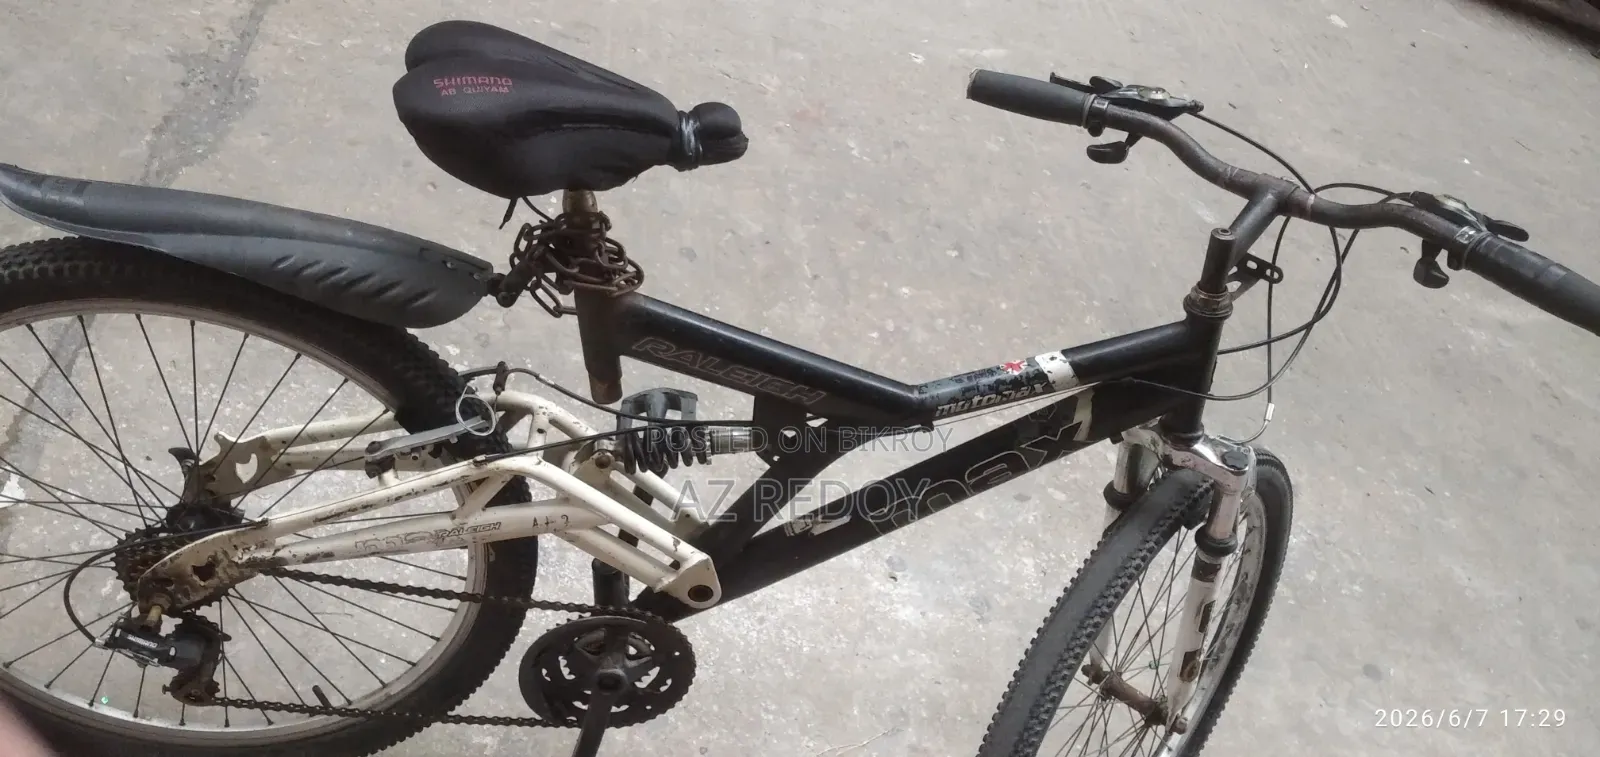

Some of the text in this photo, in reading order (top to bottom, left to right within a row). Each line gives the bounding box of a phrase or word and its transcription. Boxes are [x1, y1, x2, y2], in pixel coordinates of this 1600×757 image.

[433, 76, 512, 88] SHIMANO
[441, 88, 457, 96] AB
[632, 336, 827, 405] RALEIGH
[437, 521, 502, 539] RALEIGH
